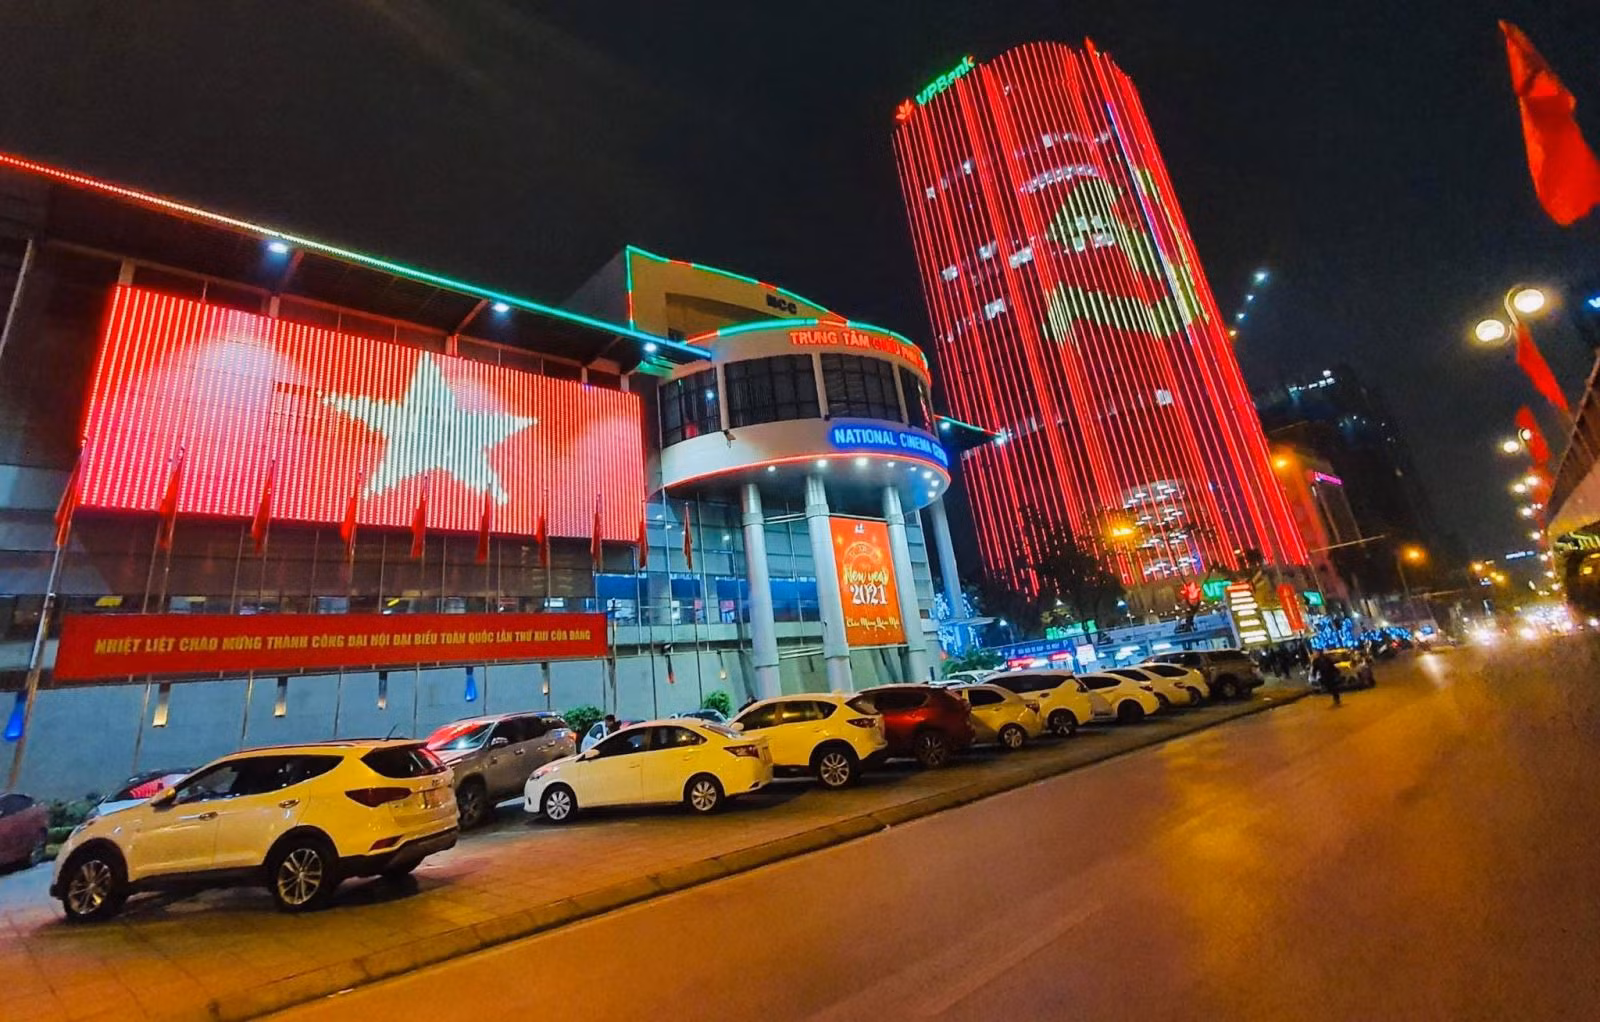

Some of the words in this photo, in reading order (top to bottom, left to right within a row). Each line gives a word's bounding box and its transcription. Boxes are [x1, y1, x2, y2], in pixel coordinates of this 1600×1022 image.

[915, 55, 975, 105] VPBank
[790, 331, 838, 345] TRUNG
[843, 330, 870, 348] TÂM
[834, 428, 898, 446] NATIONAL
[899, 432, 933, 454] CINEMA
[850, 583, 888, 604] 2021
[94, 637, 142, 655] NHIỆT
[312, 632, 344, 648] CÔNG
